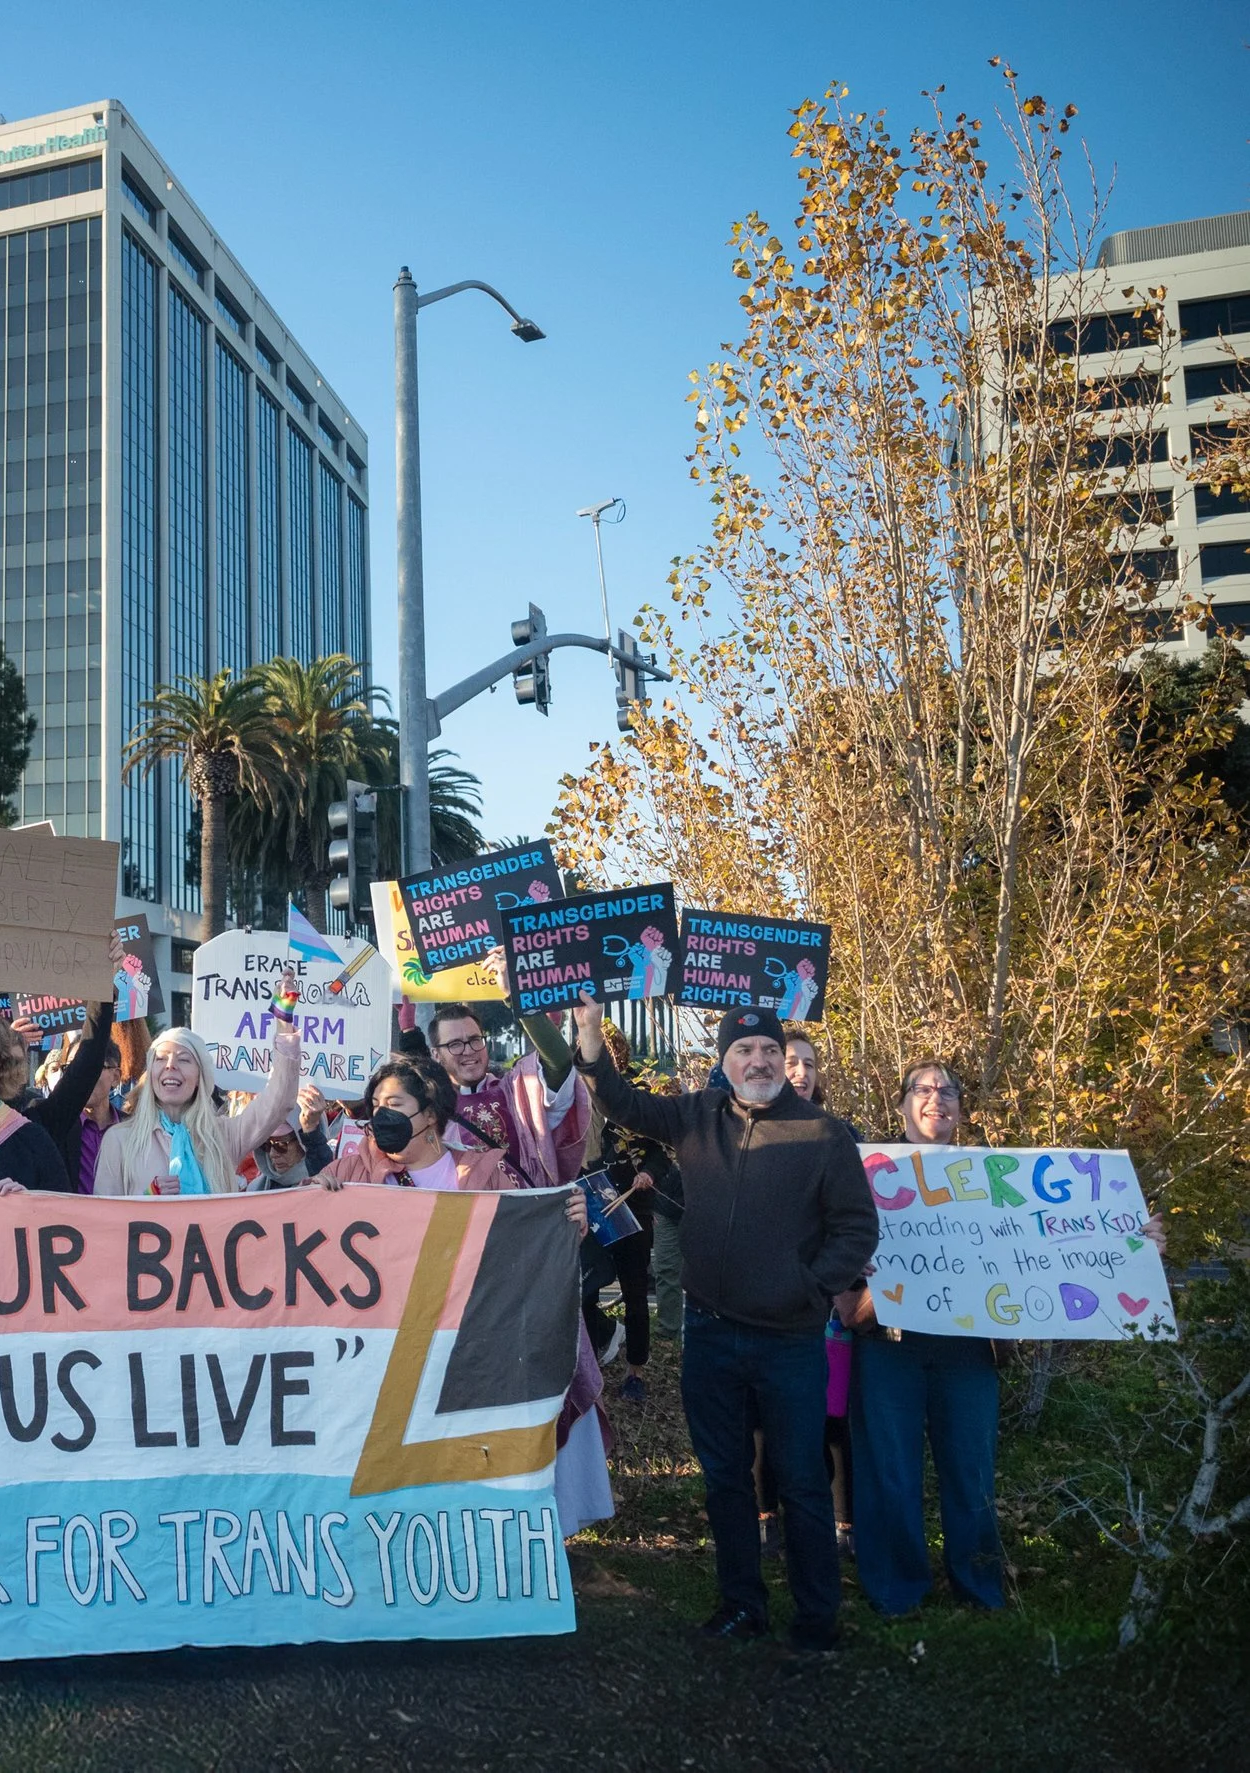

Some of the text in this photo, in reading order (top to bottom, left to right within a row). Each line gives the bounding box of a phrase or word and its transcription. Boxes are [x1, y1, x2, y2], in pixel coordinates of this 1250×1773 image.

[46, 126, 107, 153] Health
[406, 851, 545, 899] TRANSGENDER
[412, 885, 483, 917] RIGHTS
[509, 893, 665, 934] TRANSGENDER
[419, 910, 455, 933] ARE
[421, 919, 490, 951] HUMAN
[688, 918, 822, 947] TRANSGENDER
[427, 935, 497, 966] RIGHTS
[512, 925, 590, 953] RIGHTS
[686, 935, 756, 956] RIGHTS
[515, 949, 556, 972] ARE
[684, 952, 722, 969] ARE
[518, 962, 591, 991] HUMAN
[683, 969, 751, 989] HUMAN
[519, 980, 597, 1009] RIGHTS
[681, 985, 751, 1007] RIGHTS
[32, 1006, 86, 1028] IGHTS
[234, 1011, 345, 1045] AFIRM
[862, 1150, 1100, 1211] CLERGY
[990, 1217, 1023, 1236] with
[1029, 1209, 1096, 1238] TRANS
[126, 1220, 383, 1313] BACKS
[875, 1245, 1126, 1280] made in the image
[926, 1282, 1099, 1326] of GOD
[25, 1510, 148, 1606] FOR
[157, 1507, 356, 1608] TRANS
[364, 1506, 560, 1607] YOUTH
